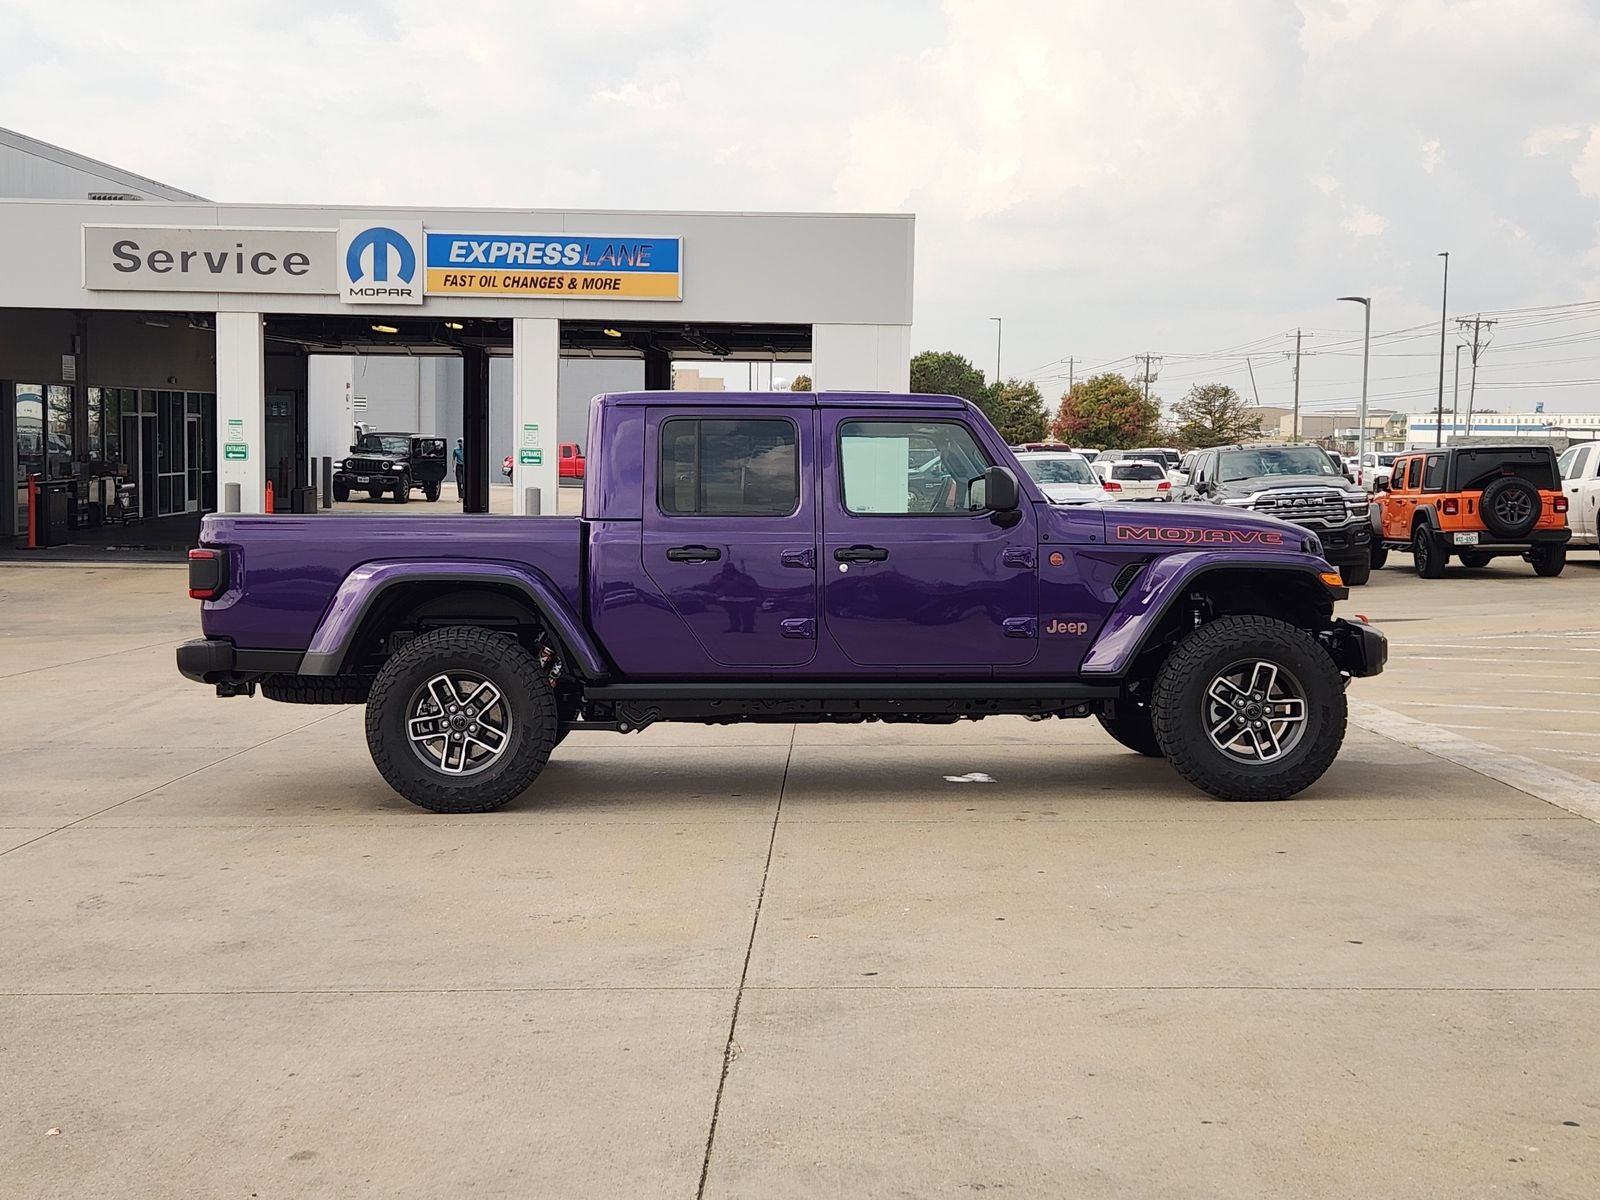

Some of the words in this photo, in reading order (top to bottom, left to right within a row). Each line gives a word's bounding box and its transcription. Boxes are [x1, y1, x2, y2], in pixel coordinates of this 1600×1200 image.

[112, 240, 311, 276] Service
[443, 274, 477, 288] FAST
[479, 275, 499, 288] OIL
[502, 275, 564, 290] CHANGES
[567, 277, 578, 290] &
[581, 277, 621, 291] MORE
[350, 288, 414, 298] MOPAR
[1277, 497, 1323, 506] RAM
[1116, 525, 1284, 545] MOJAVE
[1046, 619, 1088, 636] Jeep
